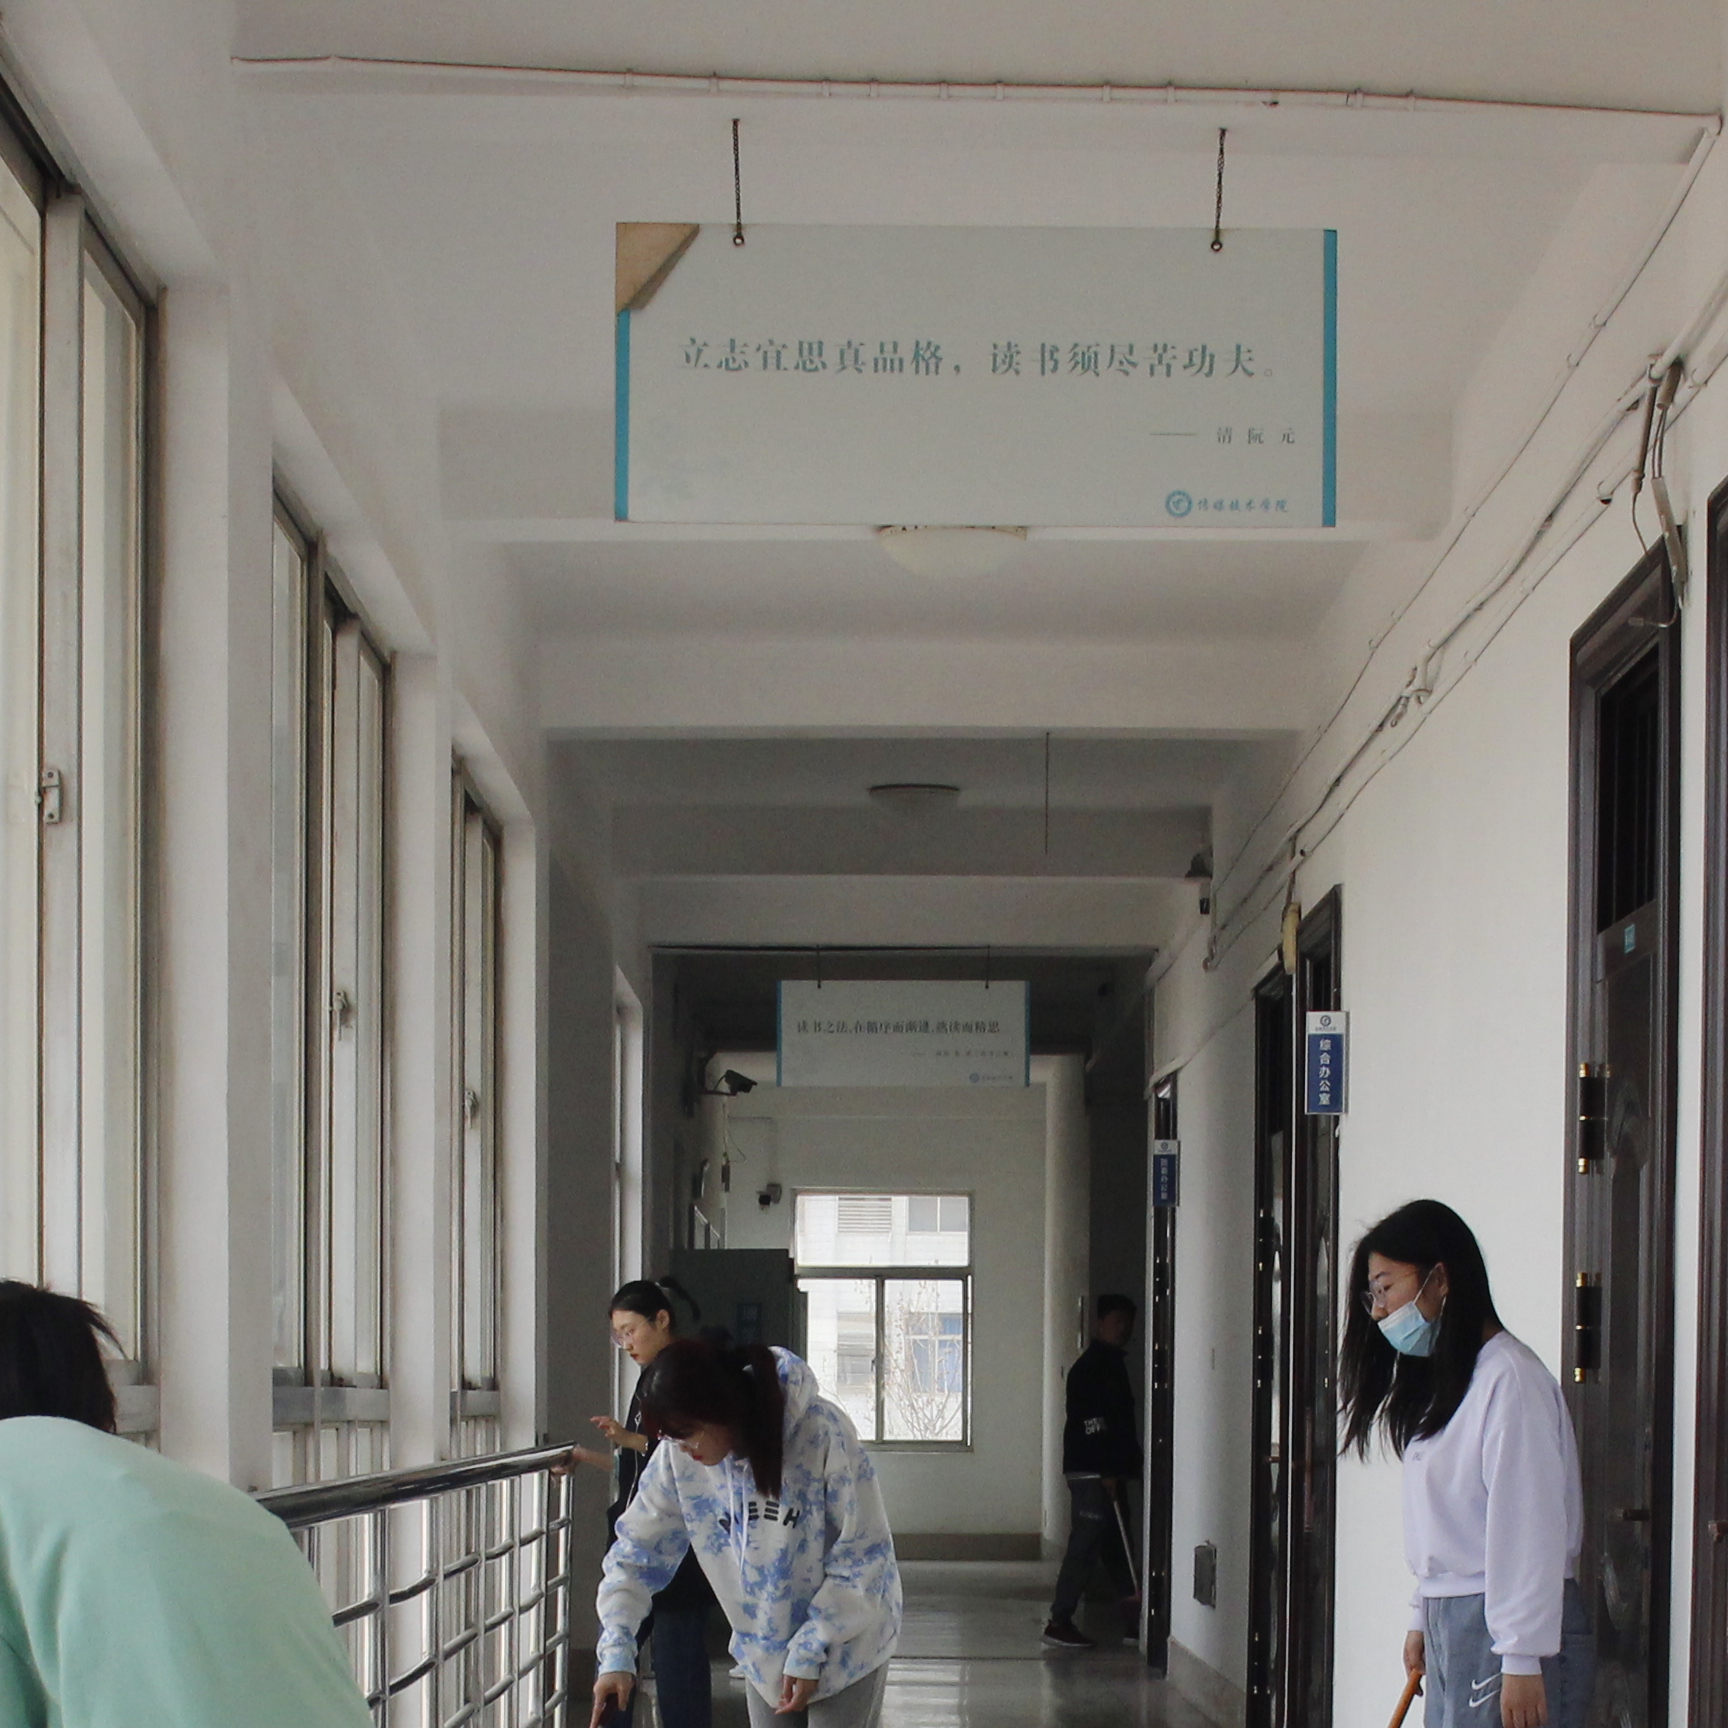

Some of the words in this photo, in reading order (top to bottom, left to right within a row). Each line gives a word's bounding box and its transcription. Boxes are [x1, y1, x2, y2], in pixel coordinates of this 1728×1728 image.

[1318, 1038, 1332, 1106] 综合办公室
